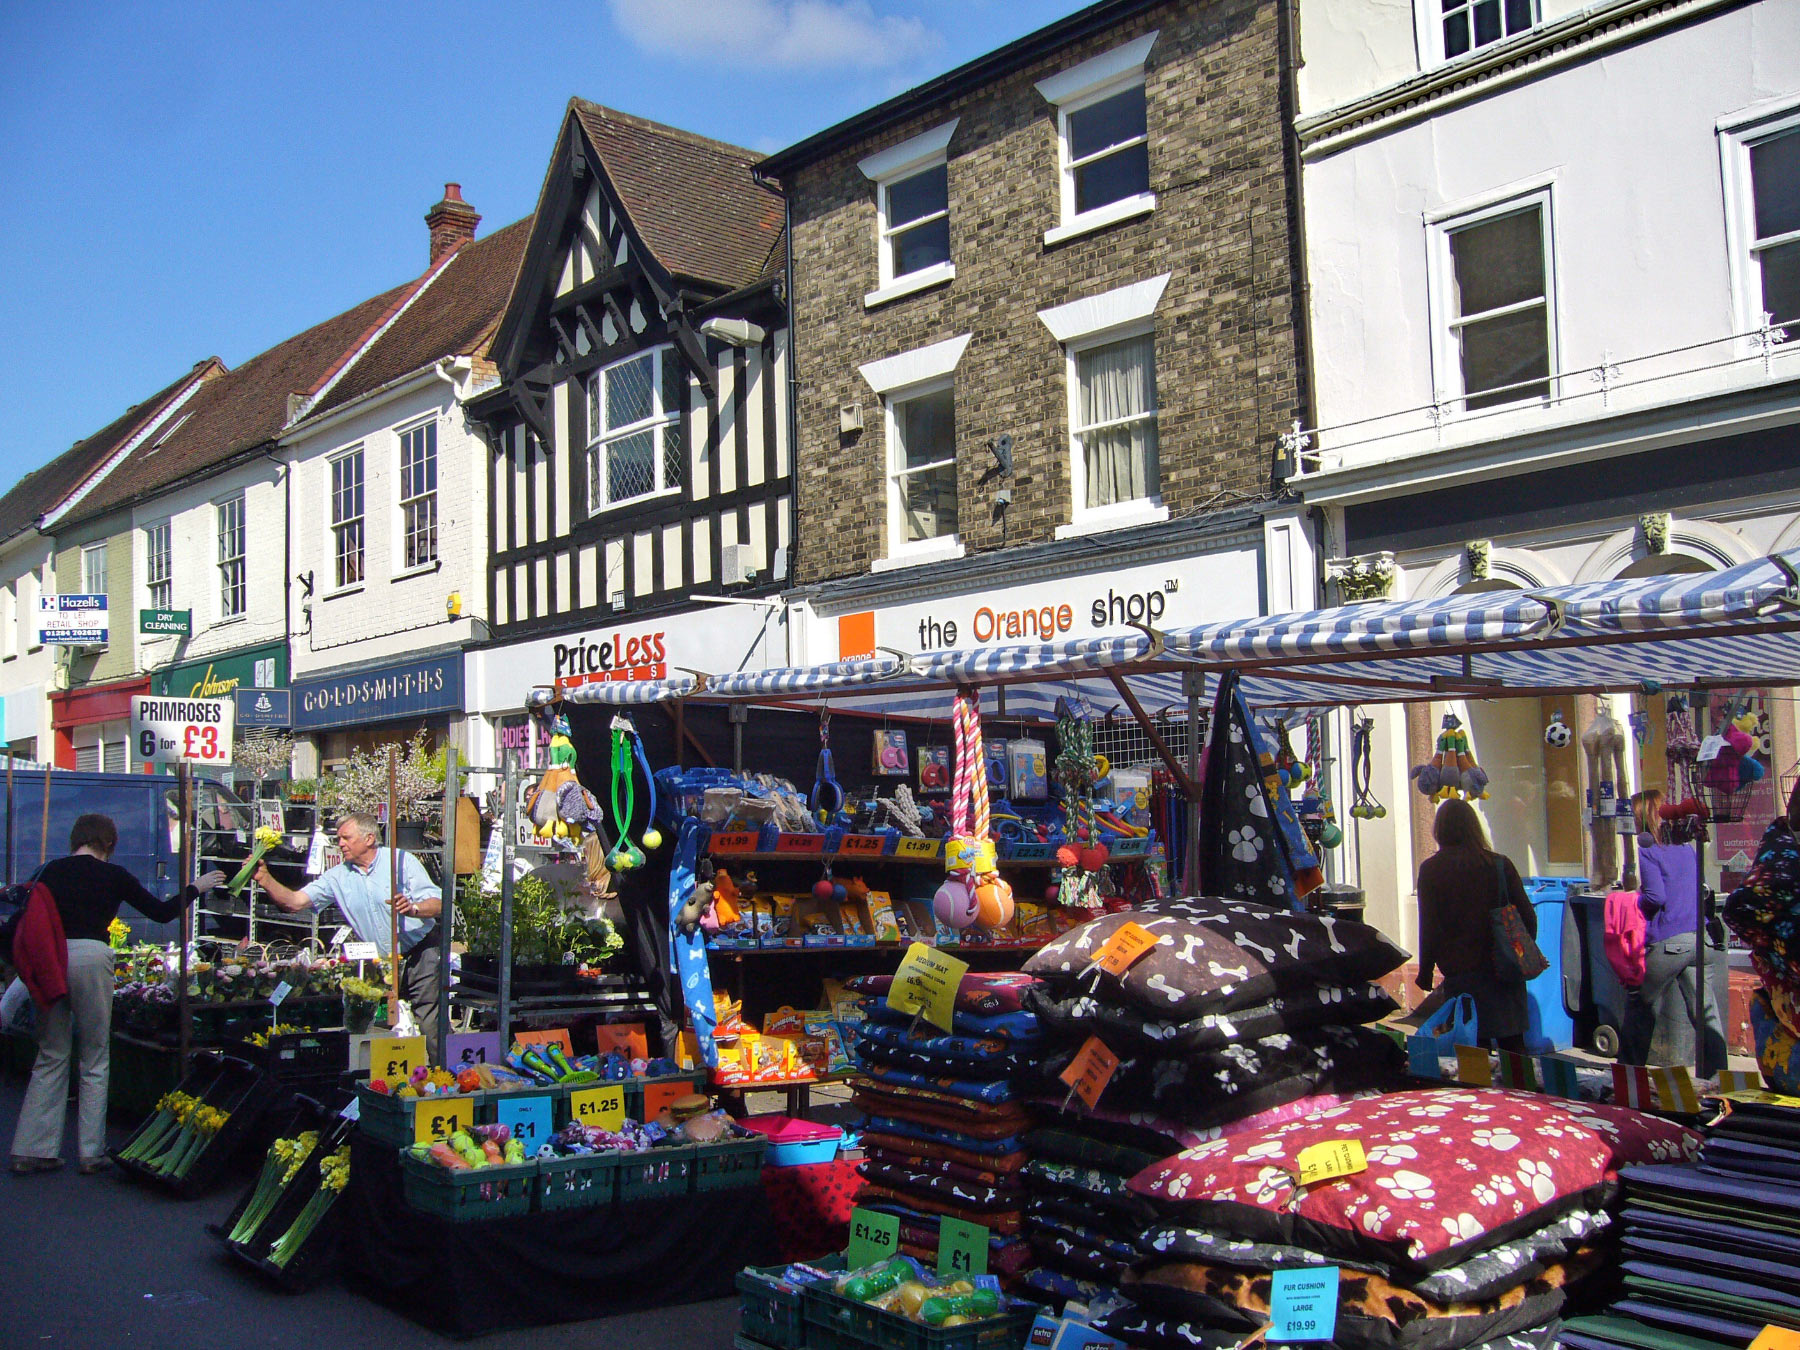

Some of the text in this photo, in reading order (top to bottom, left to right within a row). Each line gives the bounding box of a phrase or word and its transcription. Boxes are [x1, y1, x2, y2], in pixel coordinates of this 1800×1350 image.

[60, 596, 100, 608] Hazells
[47, 620, 99, 628] RETAIL SHOP
[157, 613, 174, 621] DRY
[918, 615, 957, 650] the
[973, 604, 1073, 641] Orange
[1091, 588, 1165, 626] shop
[144, 621, 187, 631] CLEANING
[553, 631, 665, 677] PriceLess
[561, 665, 659, 687] SHOES
[140, 701, 221, 723] PRIMROSES
[139, 725, 226, 759] 6 for £3.
[496, 724, 530, 750] LADIES
[719, 836, 749, 846] £1.99
[846, 836, 879, 849] £1.25
[905, 841, 931, 851] £1.99
[1016, 849, 1046, 858] £2.25
[916, 955, 936, 969] MEDIUM
[936, 964, 949, 974] MAT
[461, 1047, 486, 1064] £1
[386, 1060, 408, 1077] £1
[579, 1098, 619, 1116] £1.25
[430, 1114, 458, 1135] £1
[513, 1121, 535, 1139] £1
[855, 1223, 891, 1246] £1.25
[951, 1249, 971, 1272] £1
[1297, 1282, 1326, 1290] CUSHION
[1292, 1304, 1313, 1312] LARGE
[1287, 1320, 1316, 1331] £19.99
